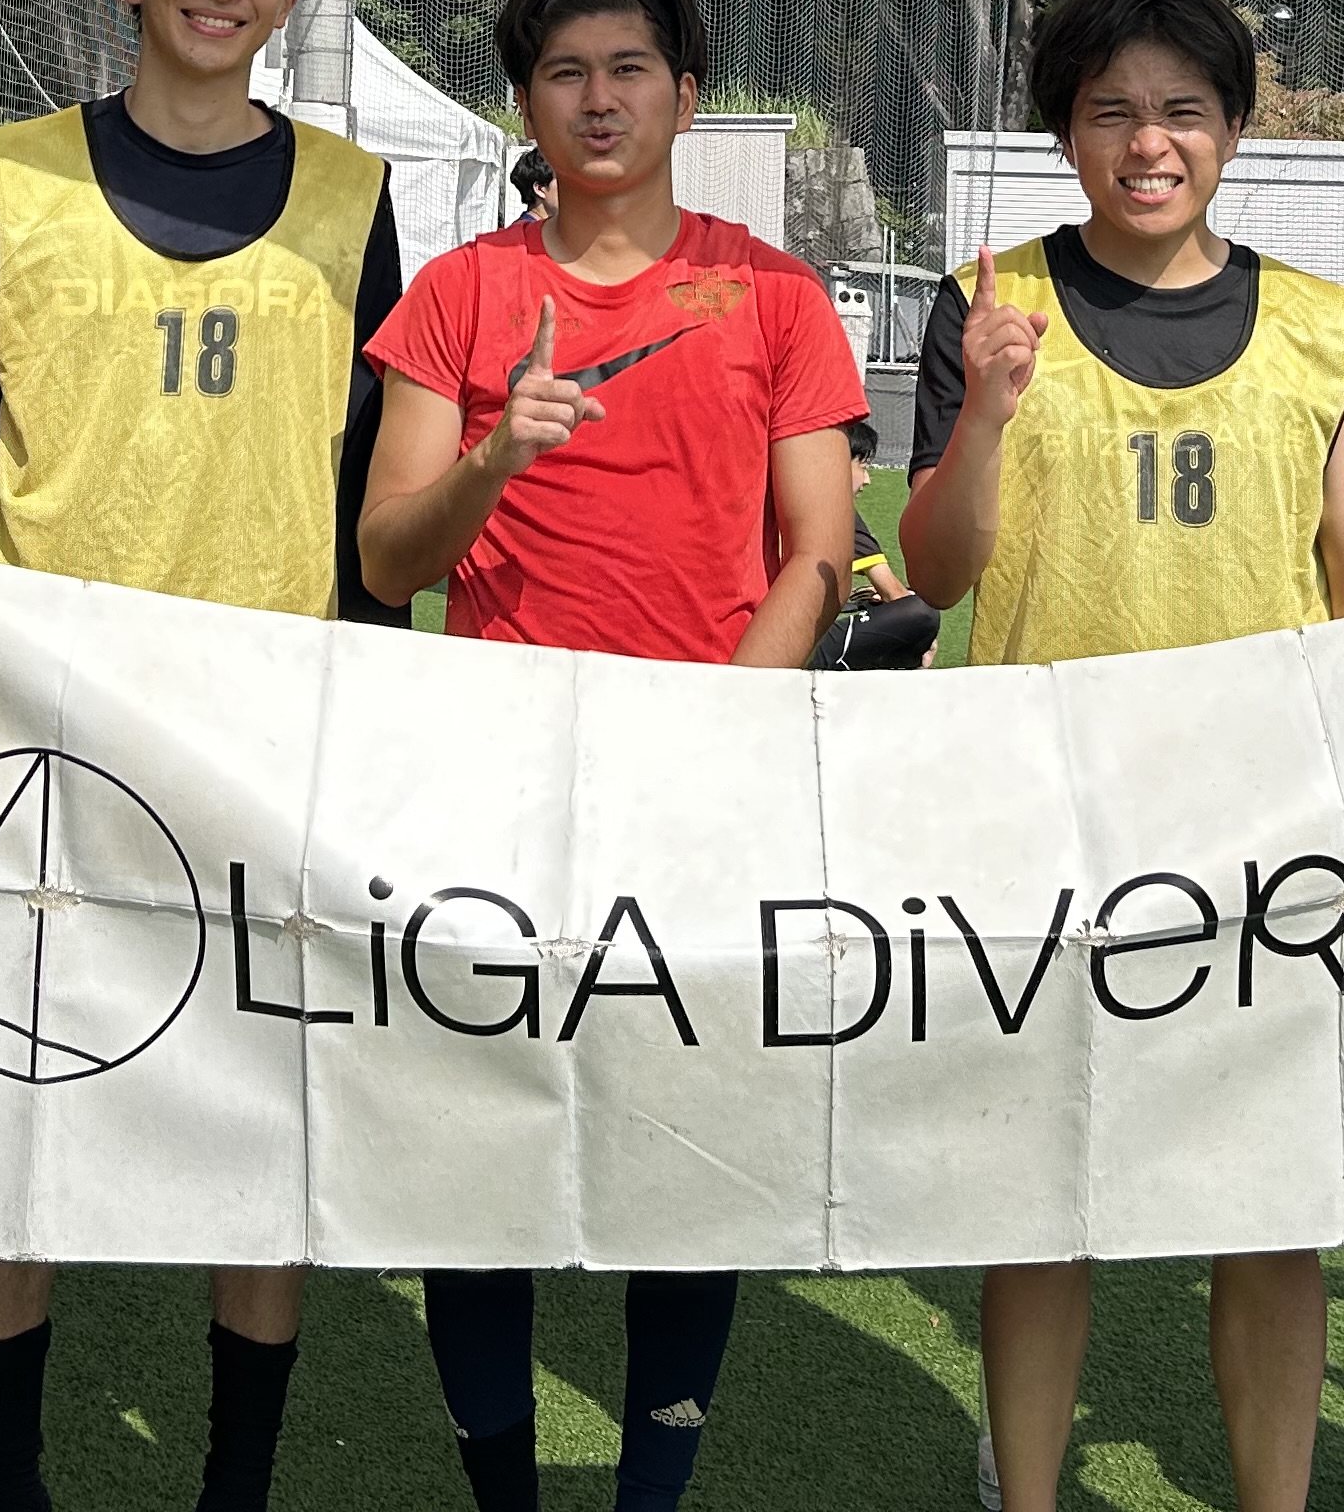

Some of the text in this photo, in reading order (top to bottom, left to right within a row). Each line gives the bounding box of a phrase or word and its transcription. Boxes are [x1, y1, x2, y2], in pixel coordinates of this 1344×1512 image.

[154, 304, 240, 399] 18
[1126, 429, 1218, 528] 18
[229, 861, 699, 1047] LiGA
